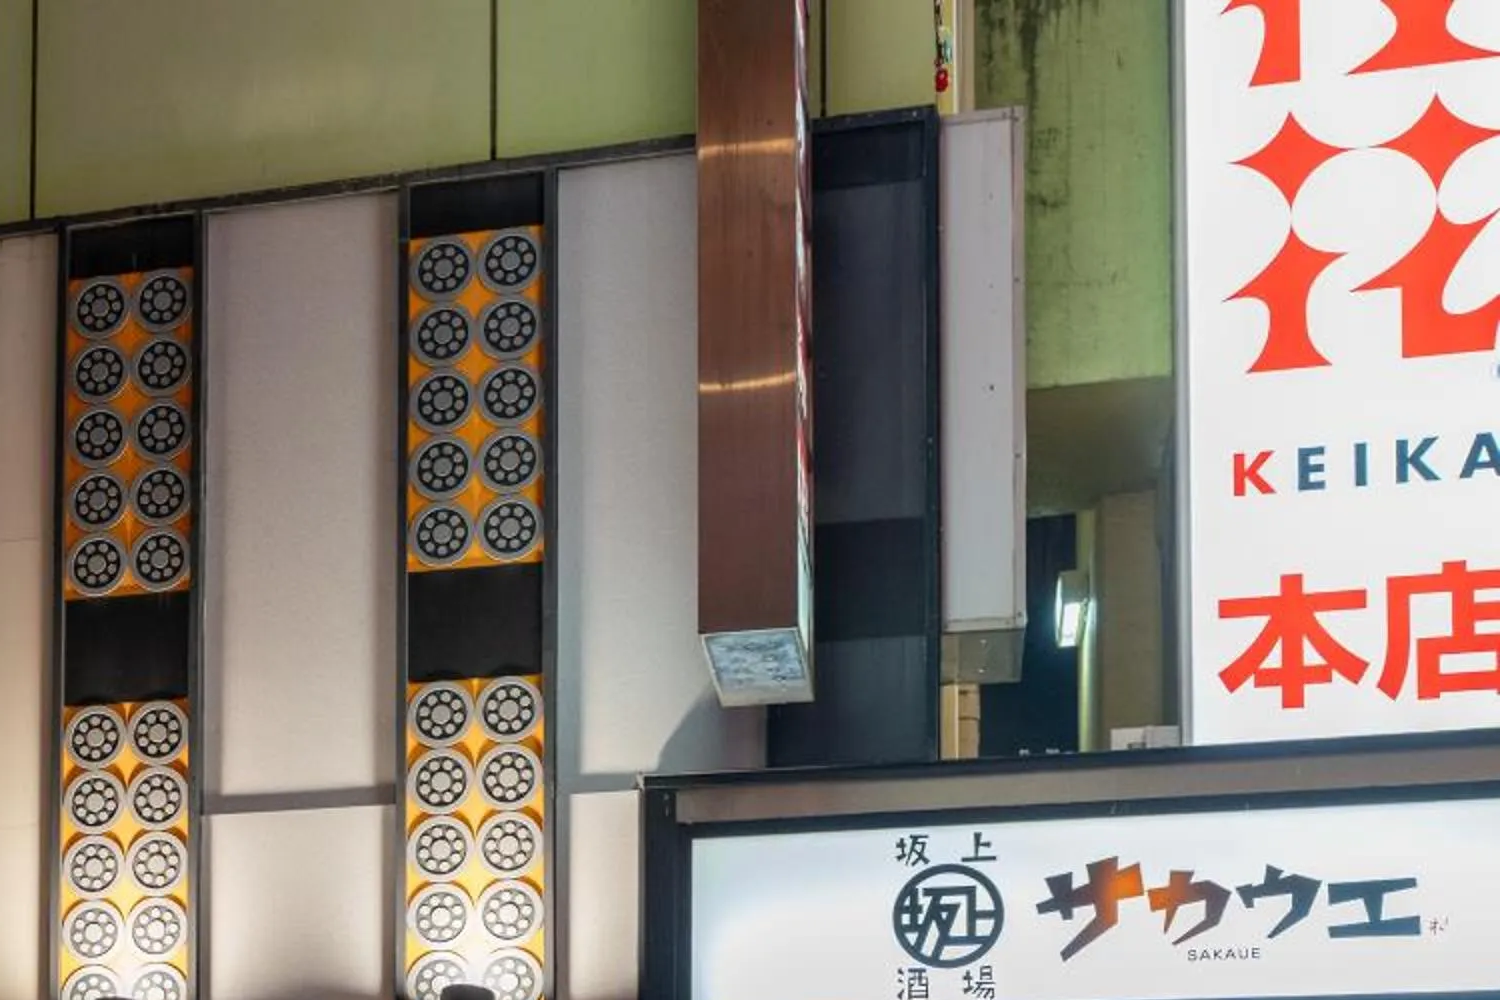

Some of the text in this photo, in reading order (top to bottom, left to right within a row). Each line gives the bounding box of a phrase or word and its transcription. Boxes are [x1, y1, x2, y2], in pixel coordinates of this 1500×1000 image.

[1220, 0, 1500, 374] 花
[1232, 432, 1500, 498] KEIKA
[1217, 560, 1500, 709] 本店
[895, 832, 997, 866] 坂上
[1035, 855, 1422, 963] サカウエ
[896, 965, 997, 1000] 酒場
[1186, 947, 1261, 962] SAKAUE
